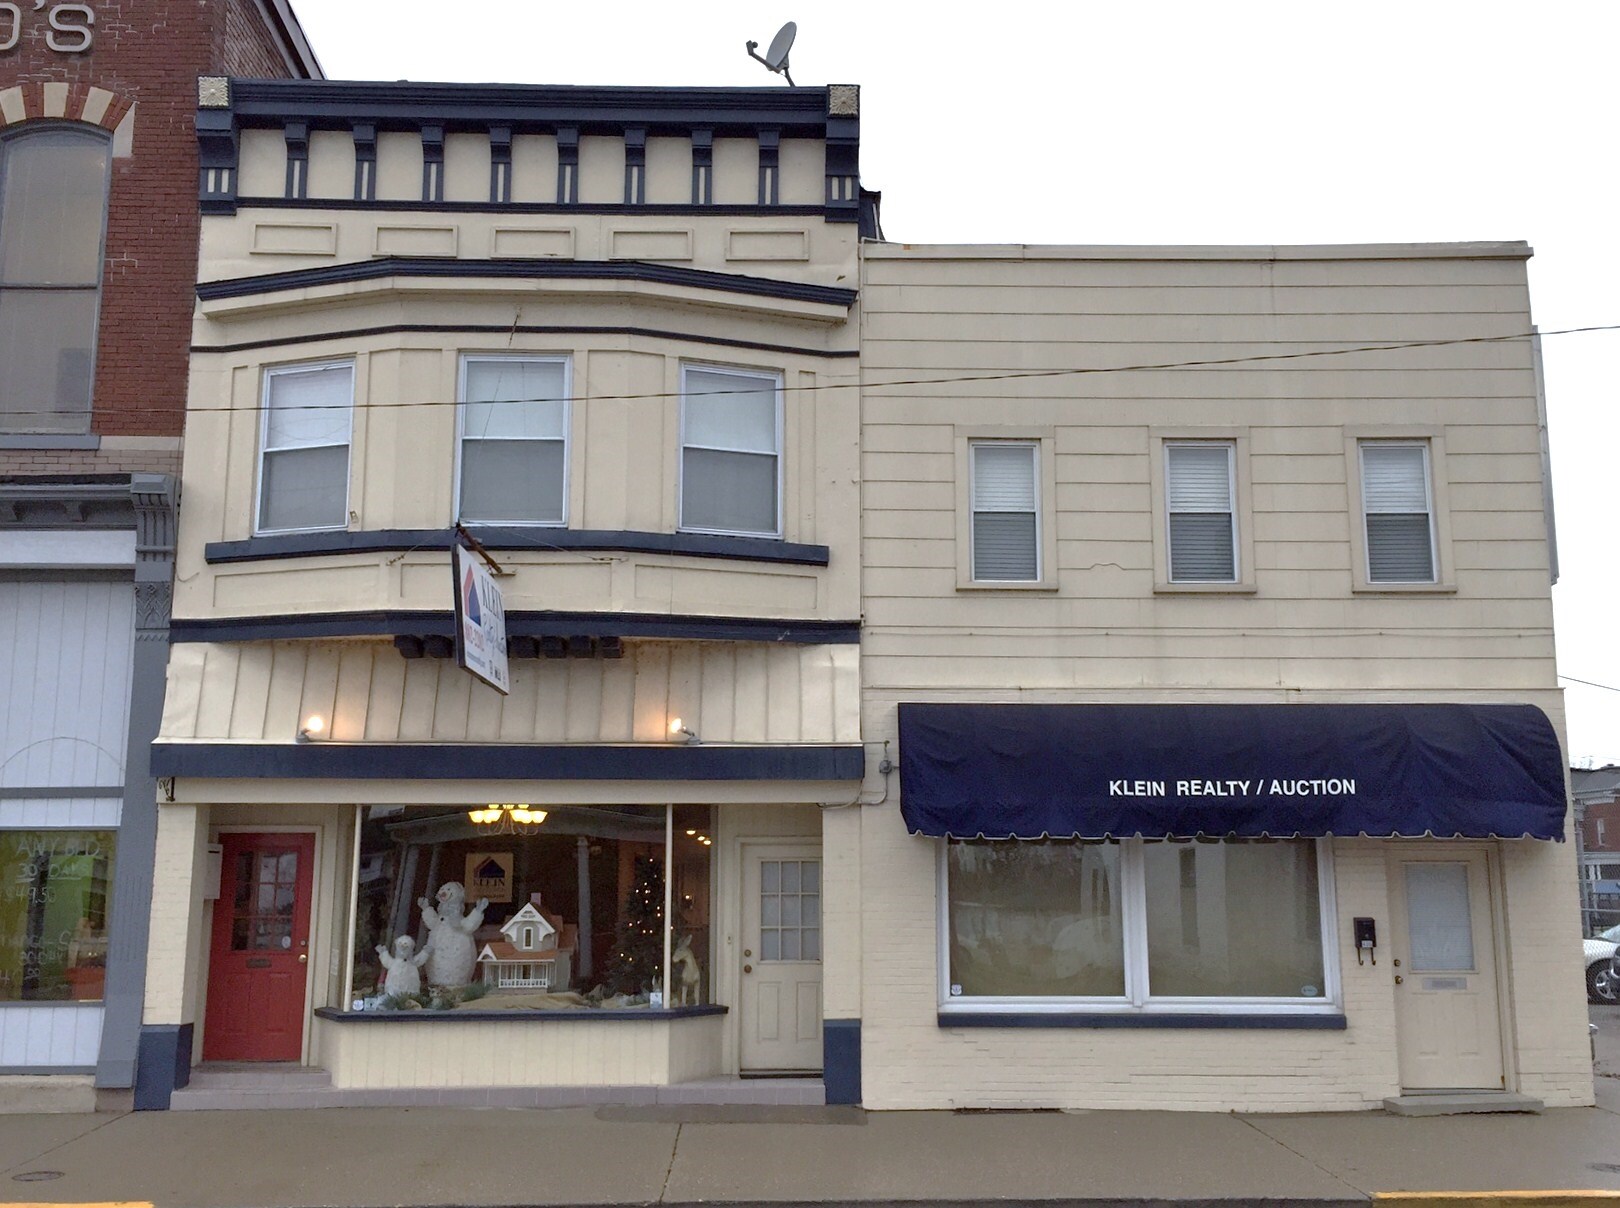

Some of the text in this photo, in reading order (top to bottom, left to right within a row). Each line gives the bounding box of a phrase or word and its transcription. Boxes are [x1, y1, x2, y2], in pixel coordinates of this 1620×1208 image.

[1109, 780, 1165, 796] KLEIN
[1176, 780, 1250, 796] REALTY
[1269, 778, 1356, 795] AUCTION
